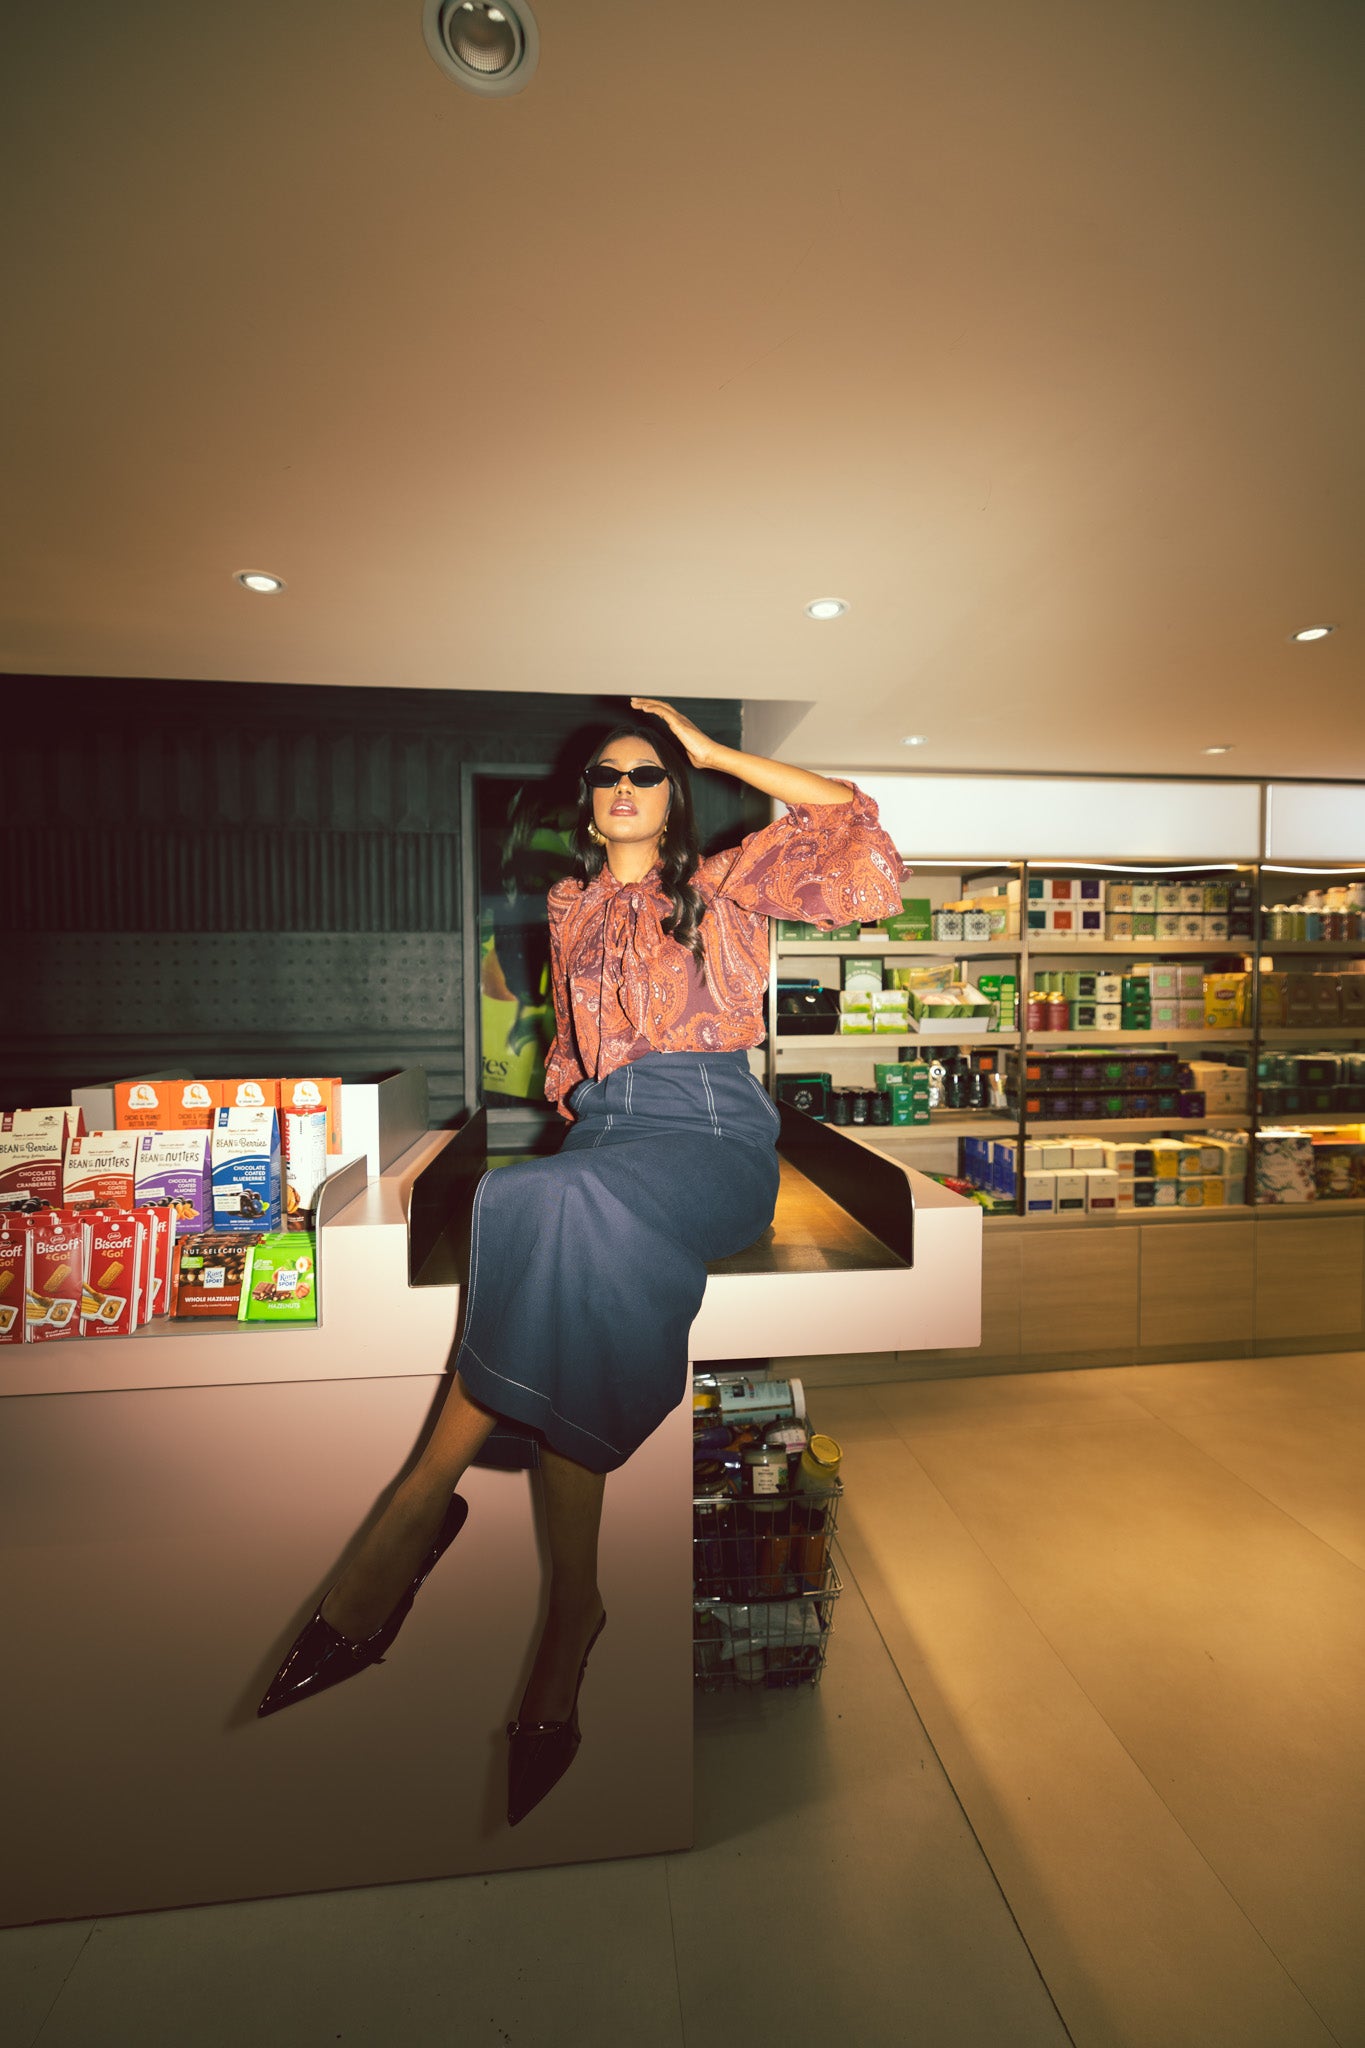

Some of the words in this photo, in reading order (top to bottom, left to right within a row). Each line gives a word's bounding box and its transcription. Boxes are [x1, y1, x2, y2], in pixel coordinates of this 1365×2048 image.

[25, 1142, 58, 1153] Berries
[140, 1153, 159, 1163] BEAN
[68, 1159, 88, 1169] BEAN
[18, 1169, 56, 1177] CHOCOLATE
[36, 1238, 79, 1255] Biscoff
[94, 1236, 133, 1250] Biscoff
